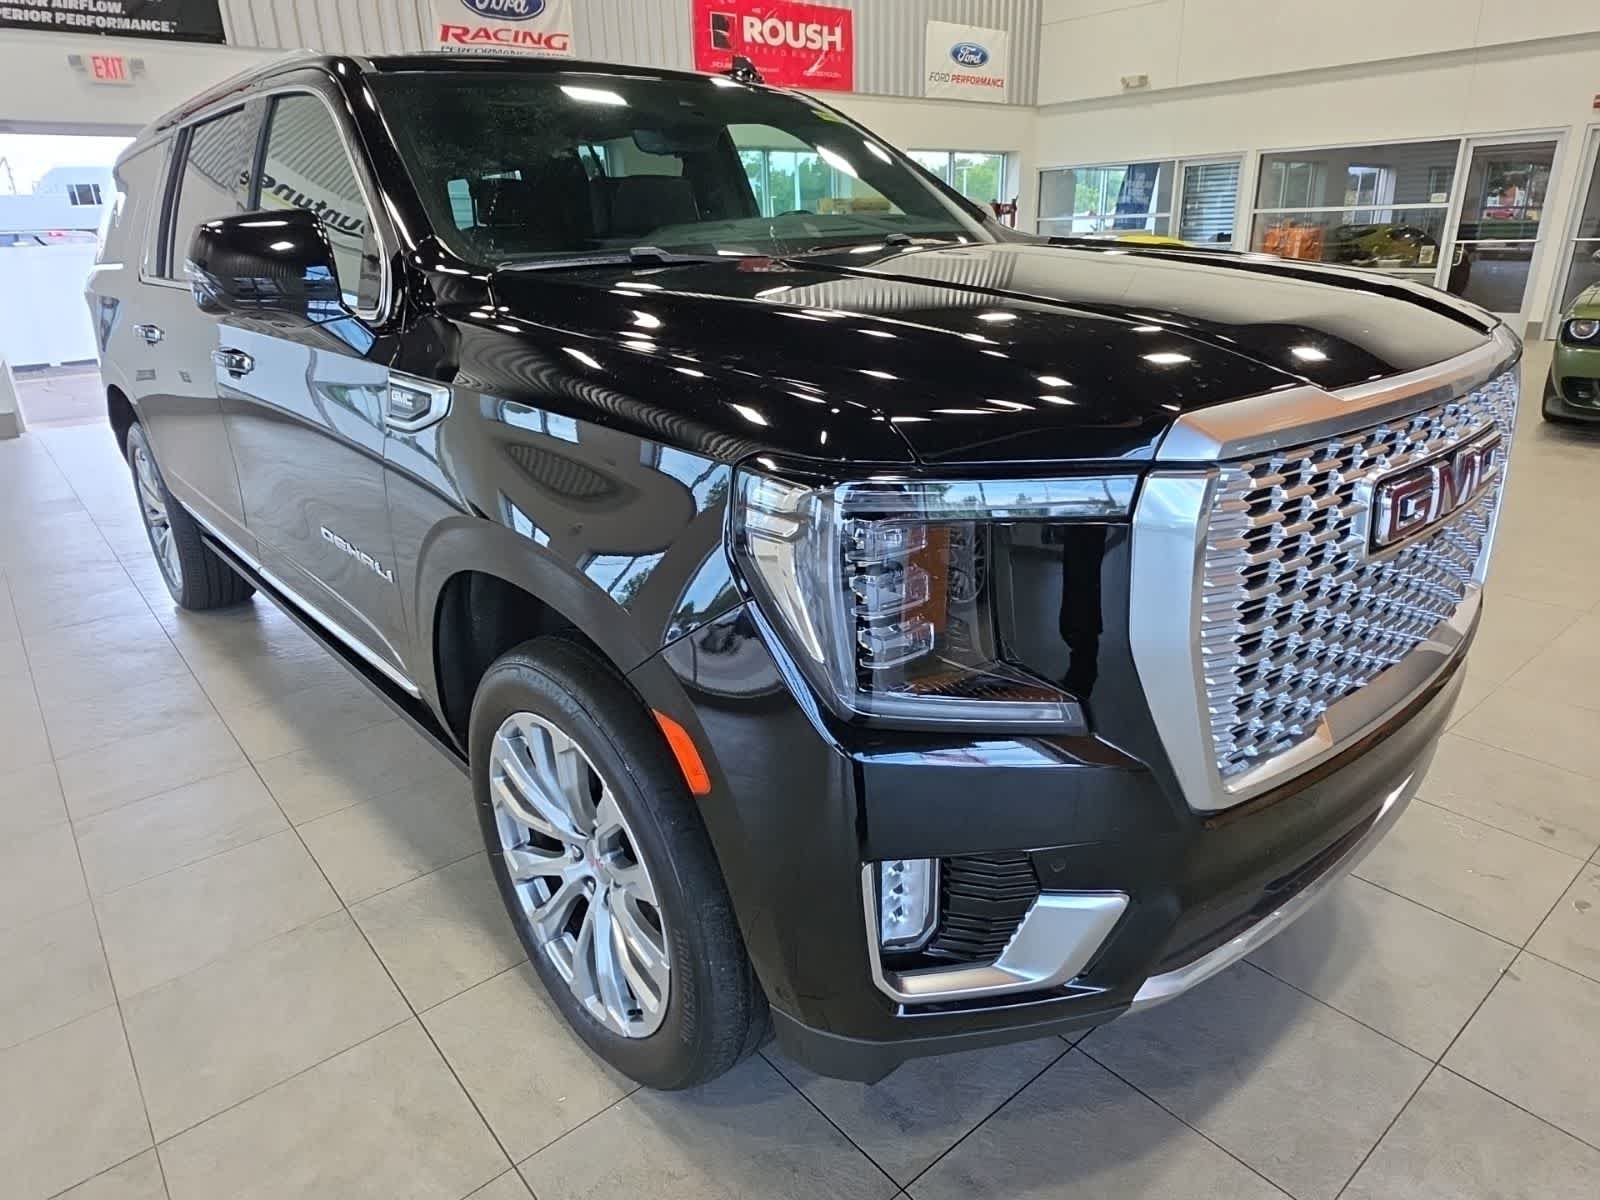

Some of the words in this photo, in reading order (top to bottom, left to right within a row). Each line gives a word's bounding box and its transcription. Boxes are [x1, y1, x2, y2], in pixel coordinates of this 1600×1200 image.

[0, 7, 52, 23] ERIOR
[440, 25, 569, 51] RACING
[743, 15, 842, 51] ROUSH
[957, 46, 983, 64] Ford
[92, 56, 126, 79] EXIT
[928, 71, 950, 83] FORD
[951, 74, 1005, 88] PERFORMANCE
[1376, 432, 1502, 545] GMC
[320, 526, 394, 584] DENALI
